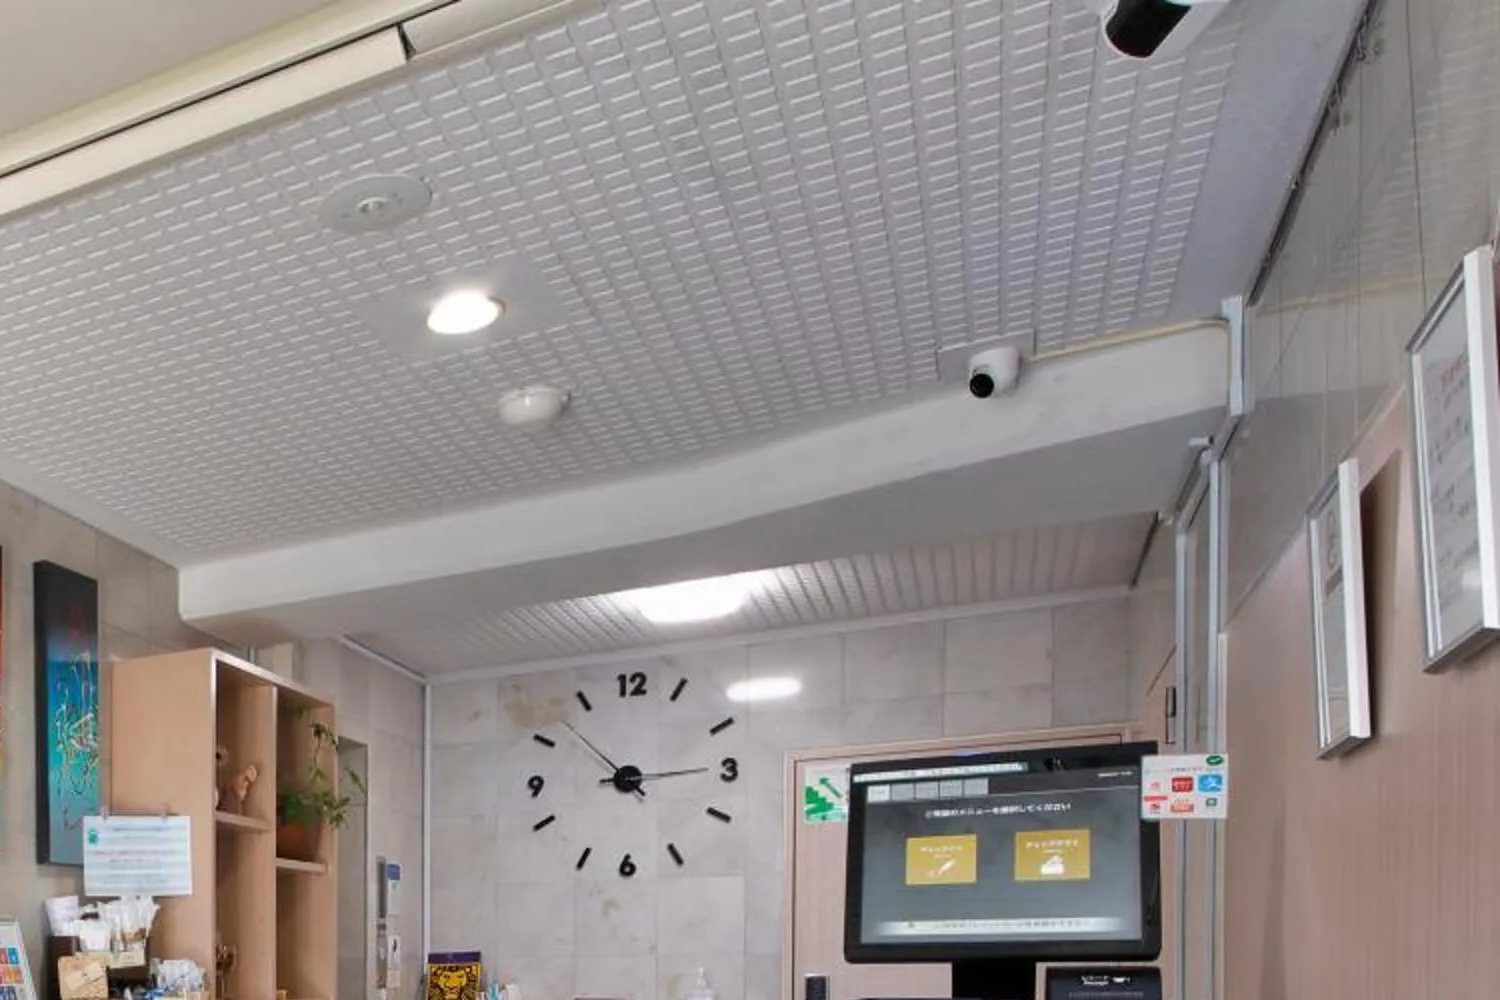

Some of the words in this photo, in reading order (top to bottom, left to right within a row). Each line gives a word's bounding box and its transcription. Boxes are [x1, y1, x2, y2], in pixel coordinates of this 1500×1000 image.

[617, 672, 647, 697] 12
[720, 758, 739, 782] 3
[527, 775, 544, 798] 9
[619, 854, 636, 877] 6
